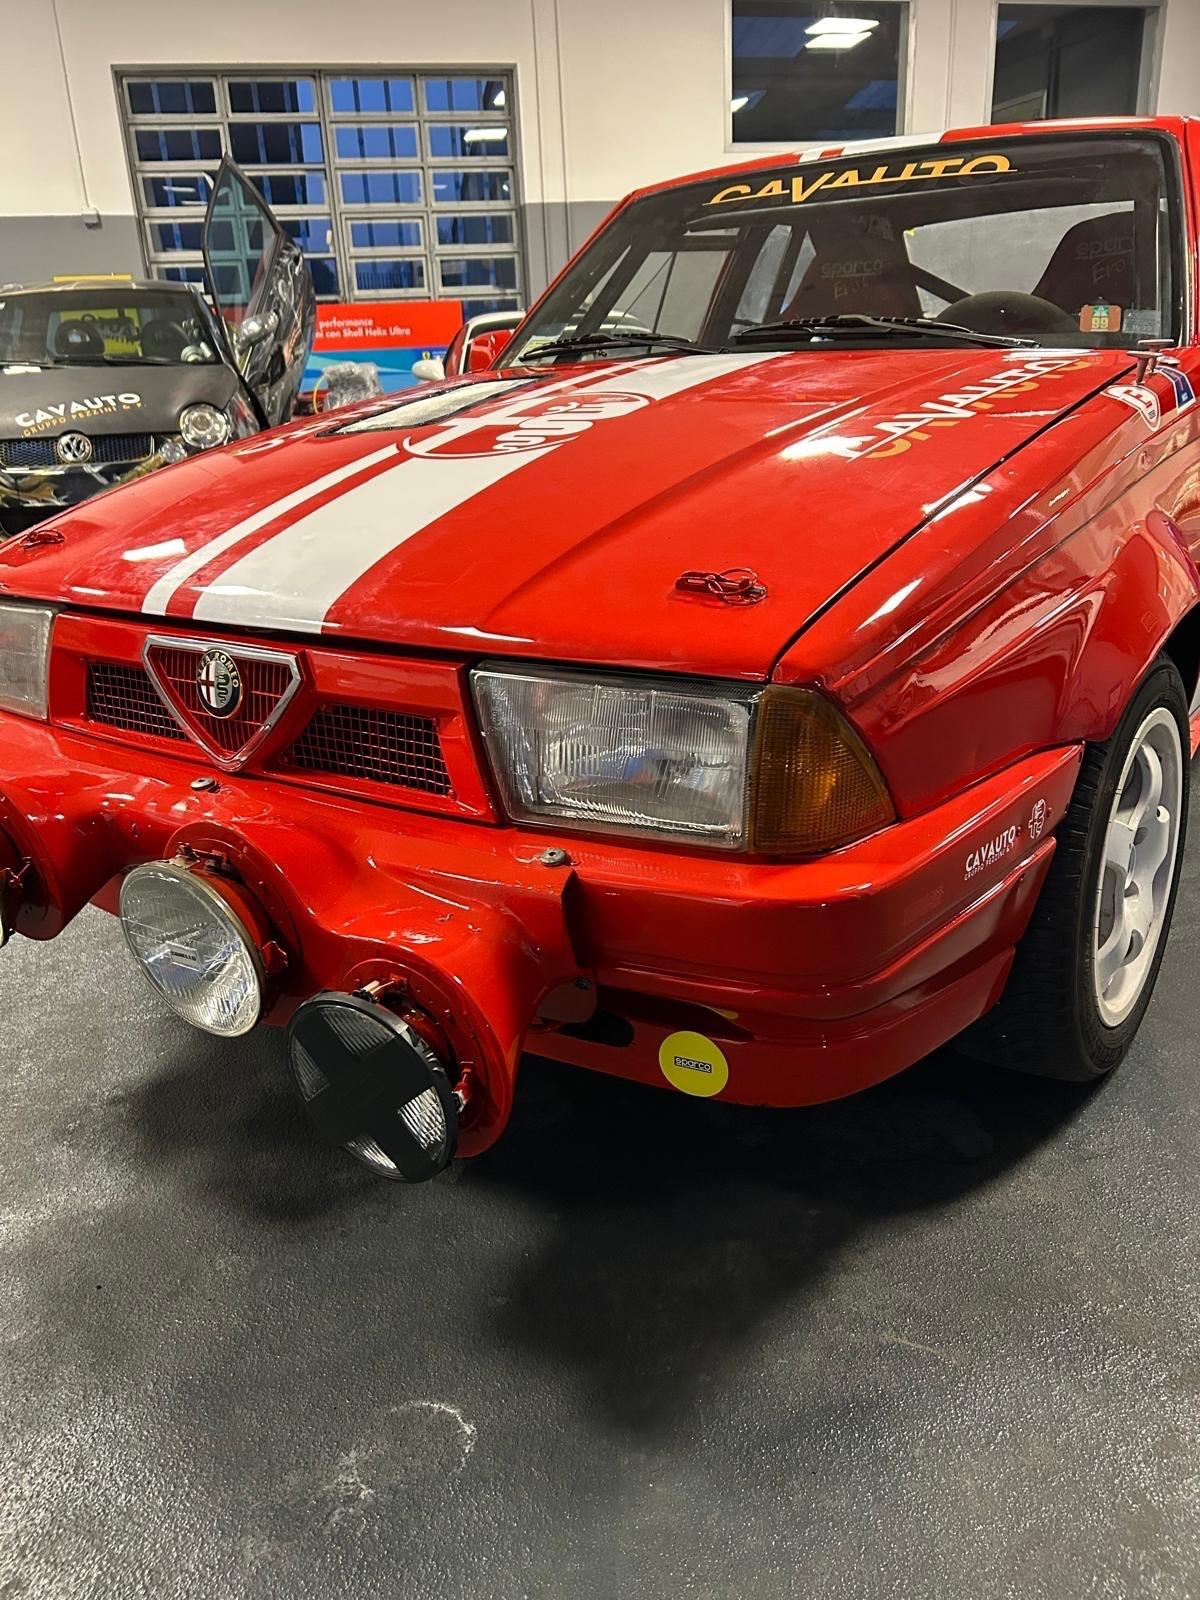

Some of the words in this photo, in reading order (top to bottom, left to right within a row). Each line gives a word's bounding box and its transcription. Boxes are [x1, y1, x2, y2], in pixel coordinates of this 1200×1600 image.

[702, 154, 1018, 207] CAVAUTO
[319, 316, 374, 329] performance
[325, 330, 342, 338] con
[343, 327, 364, 337] Shell
[365, 326, 388, 337] Helix
[388, 325, 411, 336] Ultra
[15, 392, 141, 428] CAVAUTO
[965, 825, 1016, 872] CAVAUTO
[675, 1057, 711, 1072] sparco
